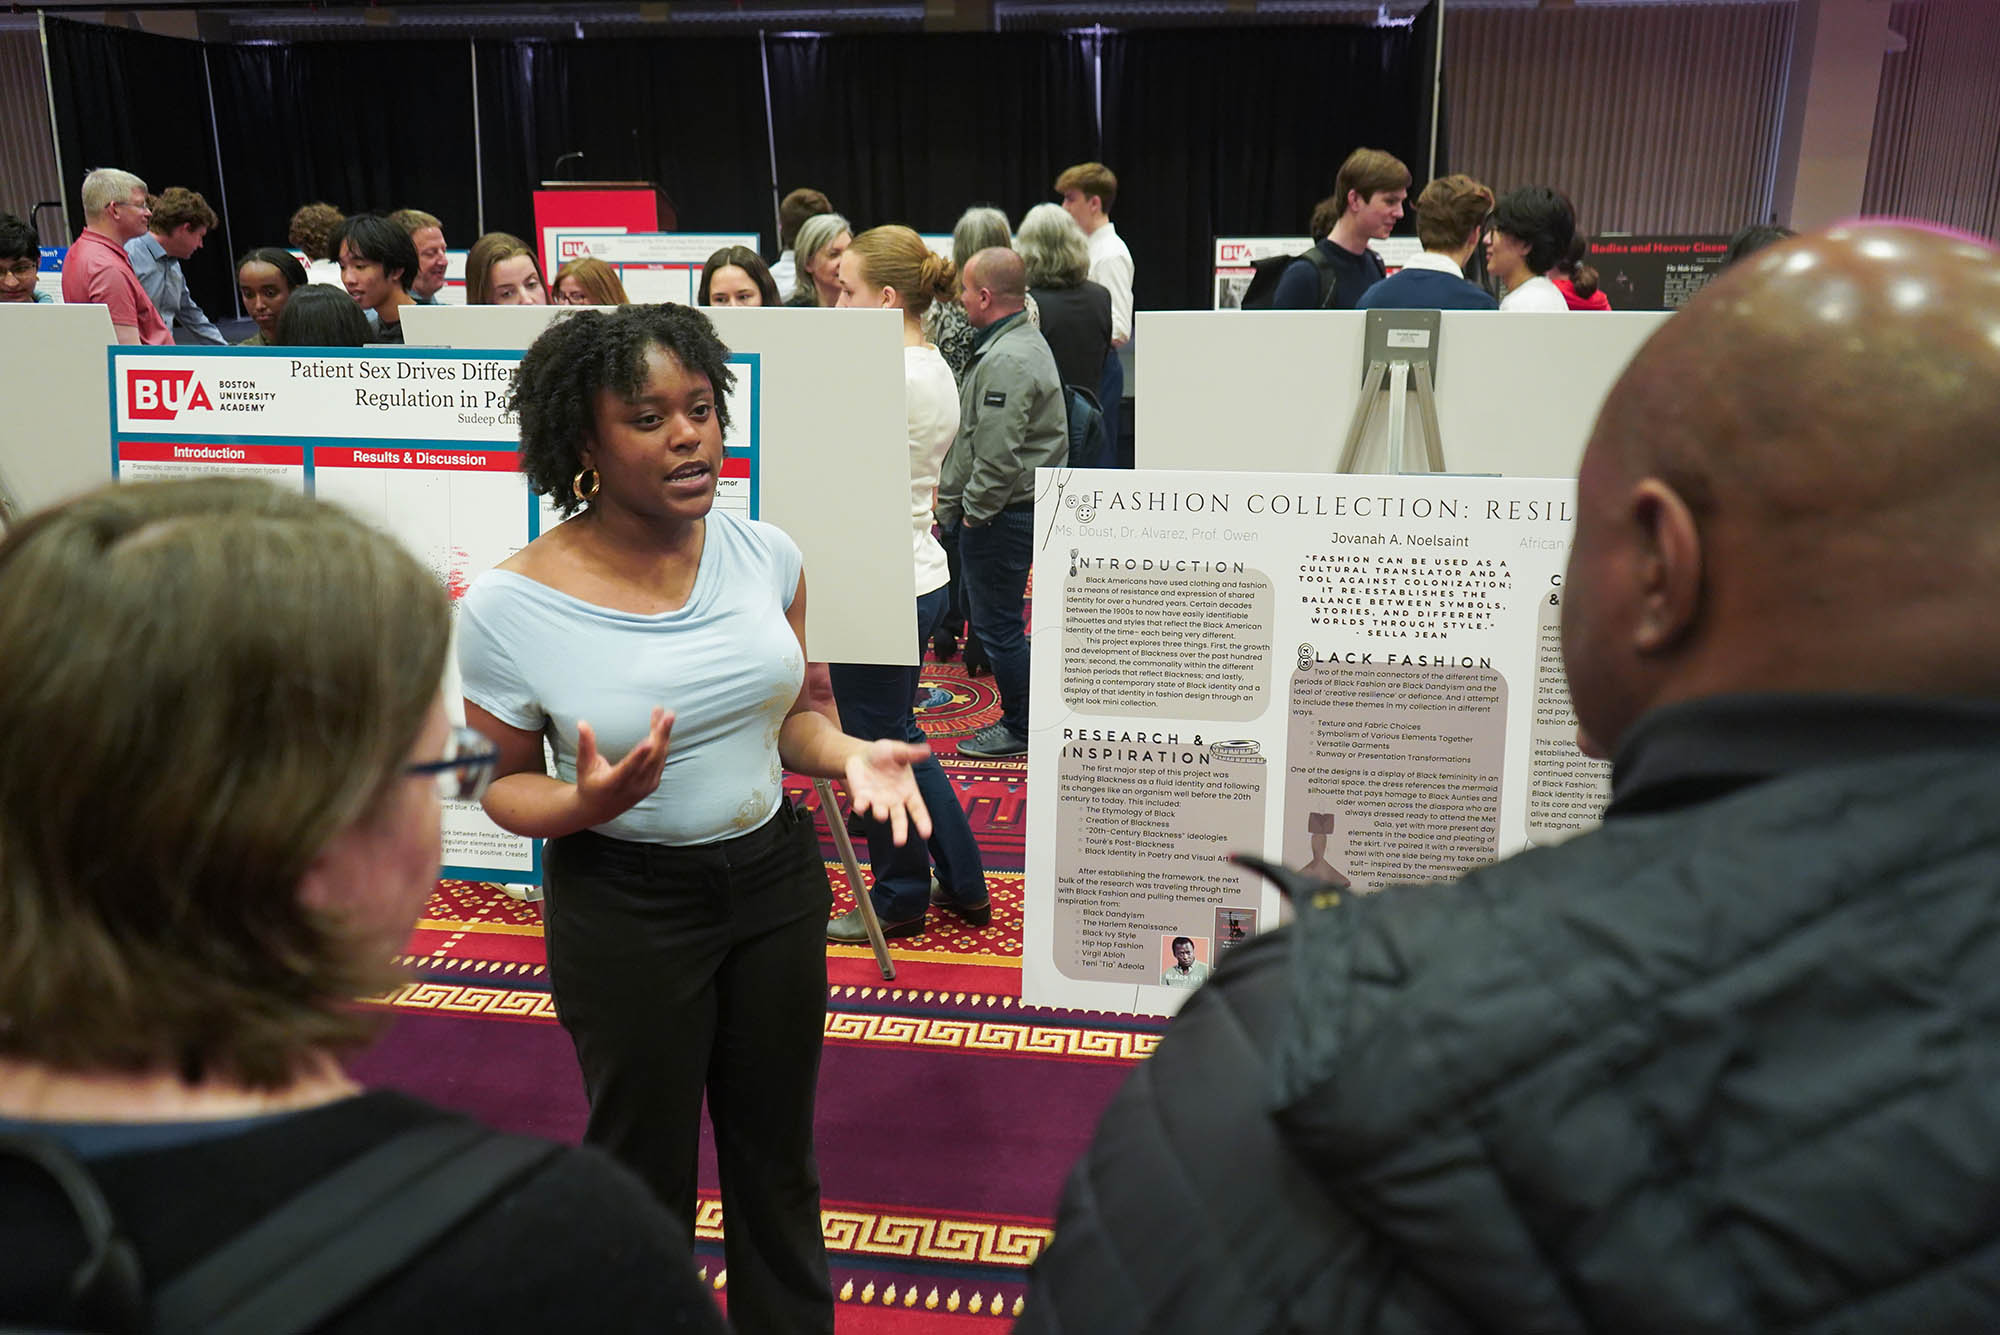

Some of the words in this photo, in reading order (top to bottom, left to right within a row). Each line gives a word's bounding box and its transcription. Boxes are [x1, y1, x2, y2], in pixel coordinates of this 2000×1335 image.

[1591, 243, 1628, 254] Bodies
[1630, 243, 1650, 254] and
[1653, 243, 1690, 253] Horror
[291, 360, 354, 378] Patient
[359, 361, 391, 378] Sex
[397, 362, 455, 380] Drives
[219, 380, 256, 389] BOSTON
[135, 377, 214, 412] BUA
[219, 392, 276, 401] UNIVERSITY
[355, 389, 454, 411] Regulation
[460, 390, 478, 408] in
[220, 403, 265, 412] ACADEMY
[458, 413, 495, 426] Sudeep
[174, 447, 245, 460] Introduction
[353, 451, 400, 464] Results
[403, 452, 413, 464] &
[416, 452, 486, 466] Discussion
[1093, 490, 1229, 513] FASHION
[1247, 494, 1468, 519] COLLECTION:
[1331, 532, 1386, 545] Jovanah
[1389, 533, 1402, 545] A.
[1407, 534, 1469, 547] Noelsaint
[1520, 537, 1564, 550] African
[1305, 555, 1370, 564] "FASHION
[1378, 556, 1403, 564] CAN
[1435, 558, 1468, 567] USED
[1300, 565, 1367, 574] CULTURAL
[1375, 567, 1462, 577] TRANSLATOR
[1469, 570, 1496, 578] AND
[1189, 580, 1221, 589] clothing
[1298, 575, 1331, 583] TOOL
[1339, 576, 1396, 585] AGAINST
[1404, 578, 1511, 589] COLONIZATION;
[1342, 587, 1454, 598] RE-ESTABLISHES
[1462, 591, 1486, 599] THE
[1302, 597, 1361, 605] BALANCE
[1369, 598, 1431, 607] BETWEEN
[1440, 600, 1506, 610] SYMBOLS,
[1549, 594, 1560, 606] &
[1315, 607, 1375, 616] STORIES,
[1383, 609, 1409, 617] AND
[1417, 610, 1491, 620] DIFFERENT
[1311, 618, 1365, 626] WORLDS
[1373, 620, 1435, 628] THROUGH
[1443, 622, 1494, 630] STYLE."
[1367, 629, 1407, 638] SELLA
[1415, 631, 1447, 639] JEAN
[1388, 655, 1491, 669] FASHION
[1318, 720, 1346, 728] Texture
[1064, 729, 1178, 745] RESEARCH
[1194, 735, 1203, 746] &
[1317, 731, 1360, 739] Symbolism
[1439, 735, 1473, 744] Together
[1317, 740, 1350, 748] Versatile
[1063, 747, 1210, 764] INSPIRATION
[1316, 751, 1346, 760] Runway
[1358, 752, 1406, 760] Presentation
[1408, 754, 1471, 763] Transformations
[1102, 808, 1143, 818] Etymology
[1086, 817, 1119, 825] Creation
[1130, 819, 1169, 827] Blackness
[1544, 822, 1582, 831] stagnant.
[1107, 849, 1137, 859] Identity
[1148, 851, 1172, 860] Poetry
[1105, 911, 1144, 920] Dandyism
[1128, 922, 1178, 931] Renaissance
[1105, 931, 1116, 940] Ivy
[1117, 932, 1136, 940] Style
[1082, 940, 1094, 948] Hip
[1096, 941, 1112, 949] Hop
[1082, 950, 1101, 959] Virgil
[1103, 951, 1125, 959] Abloh
[1118, 962, 1144, 970] Adeola
